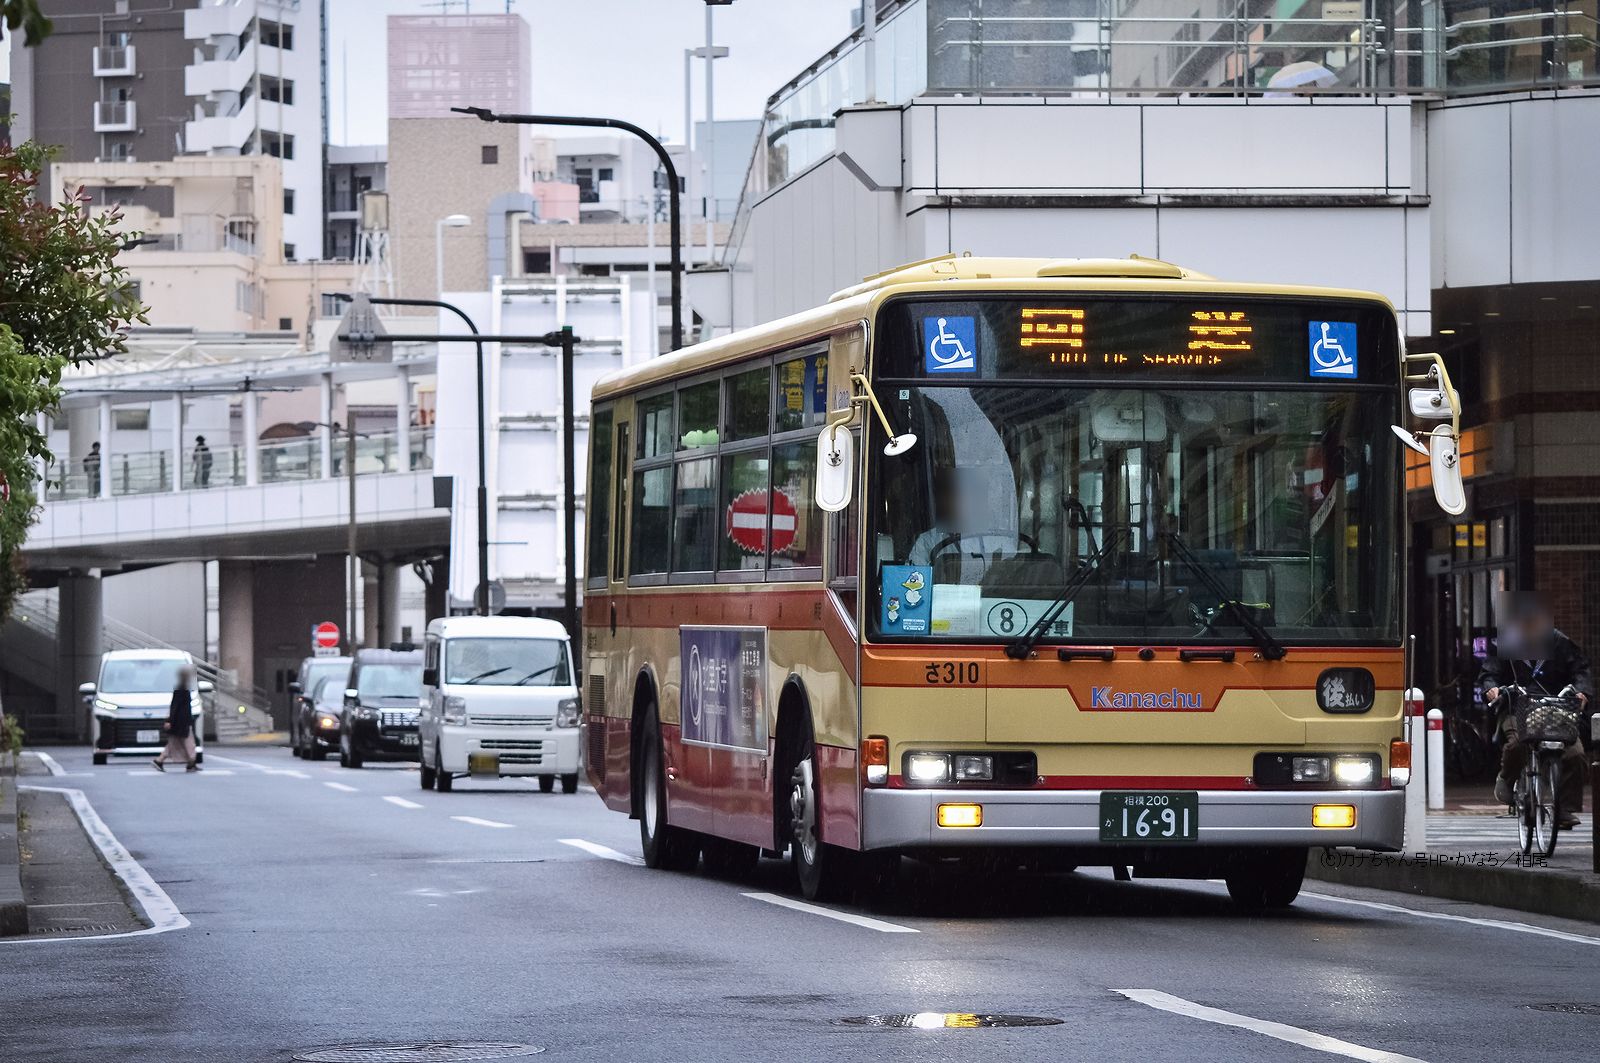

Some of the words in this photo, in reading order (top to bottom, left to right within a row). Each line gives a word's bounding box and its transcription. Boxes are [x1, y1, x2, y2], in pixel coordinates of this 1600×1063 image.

[1000, 607, 1014, 633] 8
[925, 661, 979, 684] さ310
[1091, 686, 1202, 708] Kanachu
[1323, 677, 1364, 707] 後払い
[1122, 808, 1189, 837] 16-91
